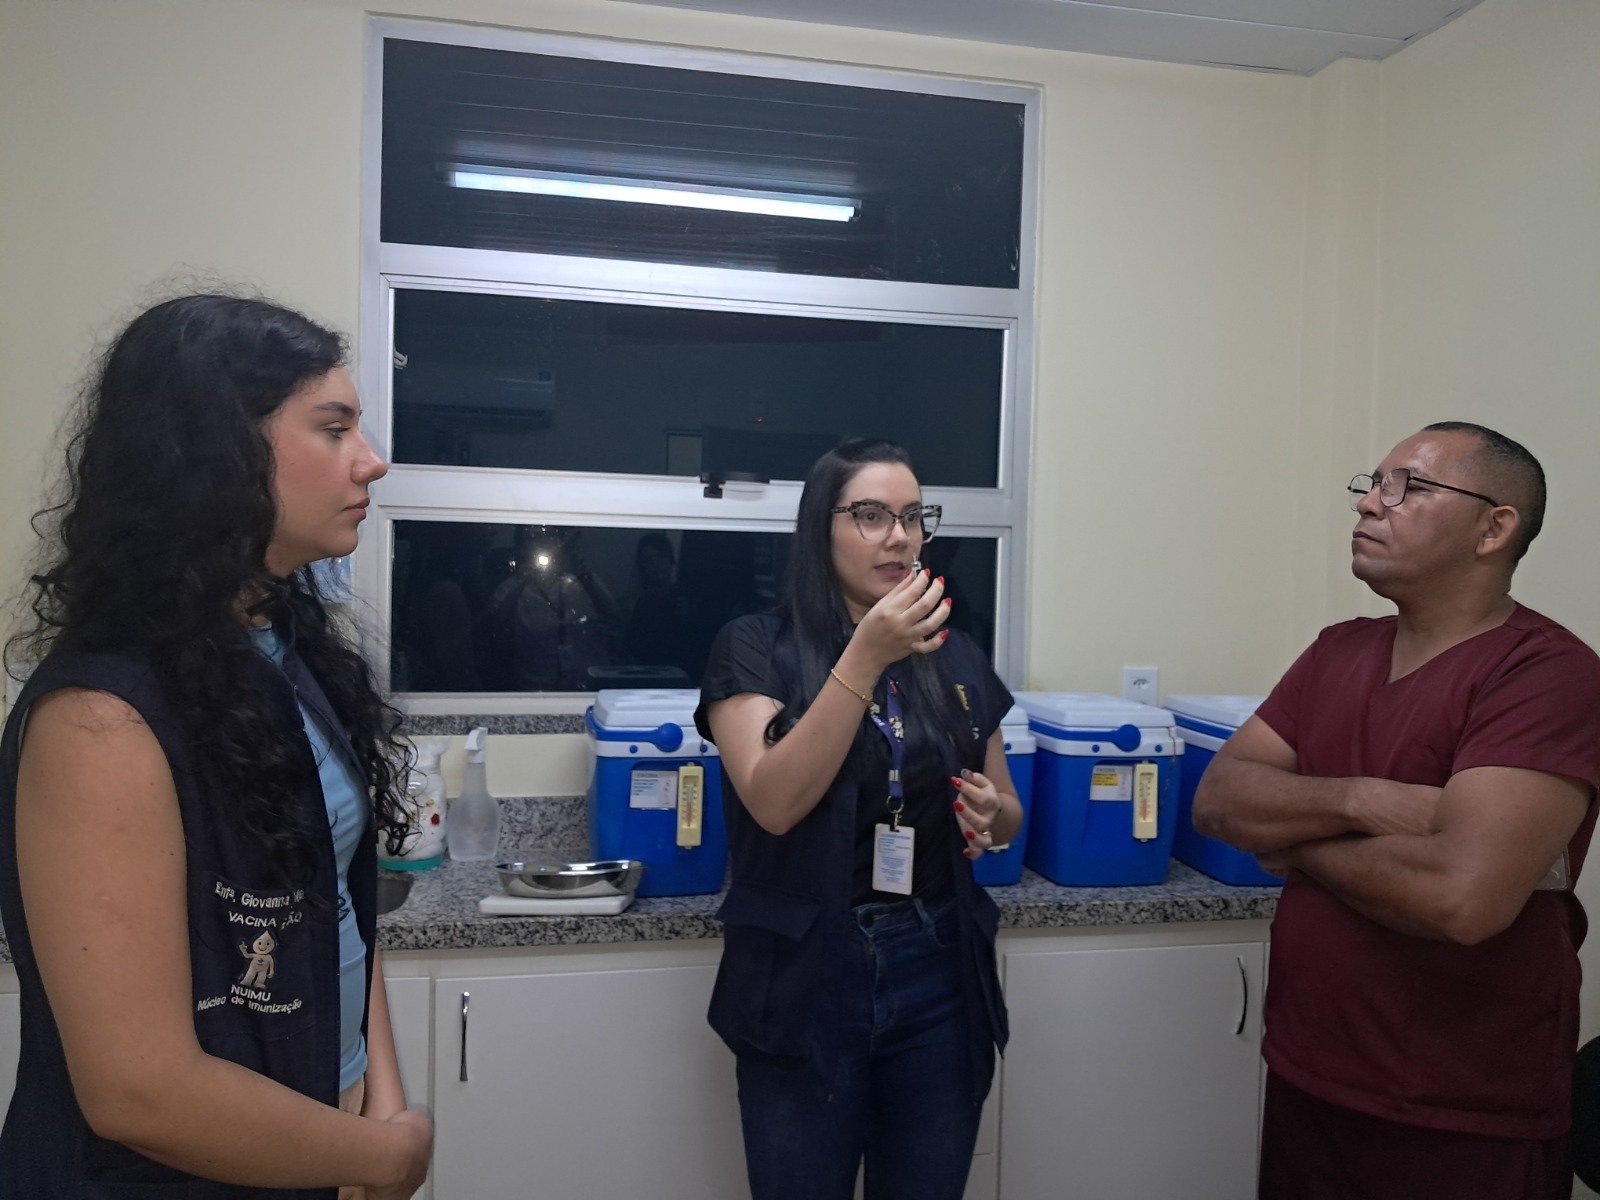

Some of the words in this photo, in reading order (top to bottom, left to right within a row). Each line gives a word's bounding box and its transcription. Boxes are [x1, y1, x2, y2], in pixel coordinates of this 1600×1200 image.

[241, 892, 290, 909] Giovanna
[230, 984, 272, 1002] NUIMU
[197, 996, 227, 1011] Núcleo
[231, 996, 245, 1006] de
